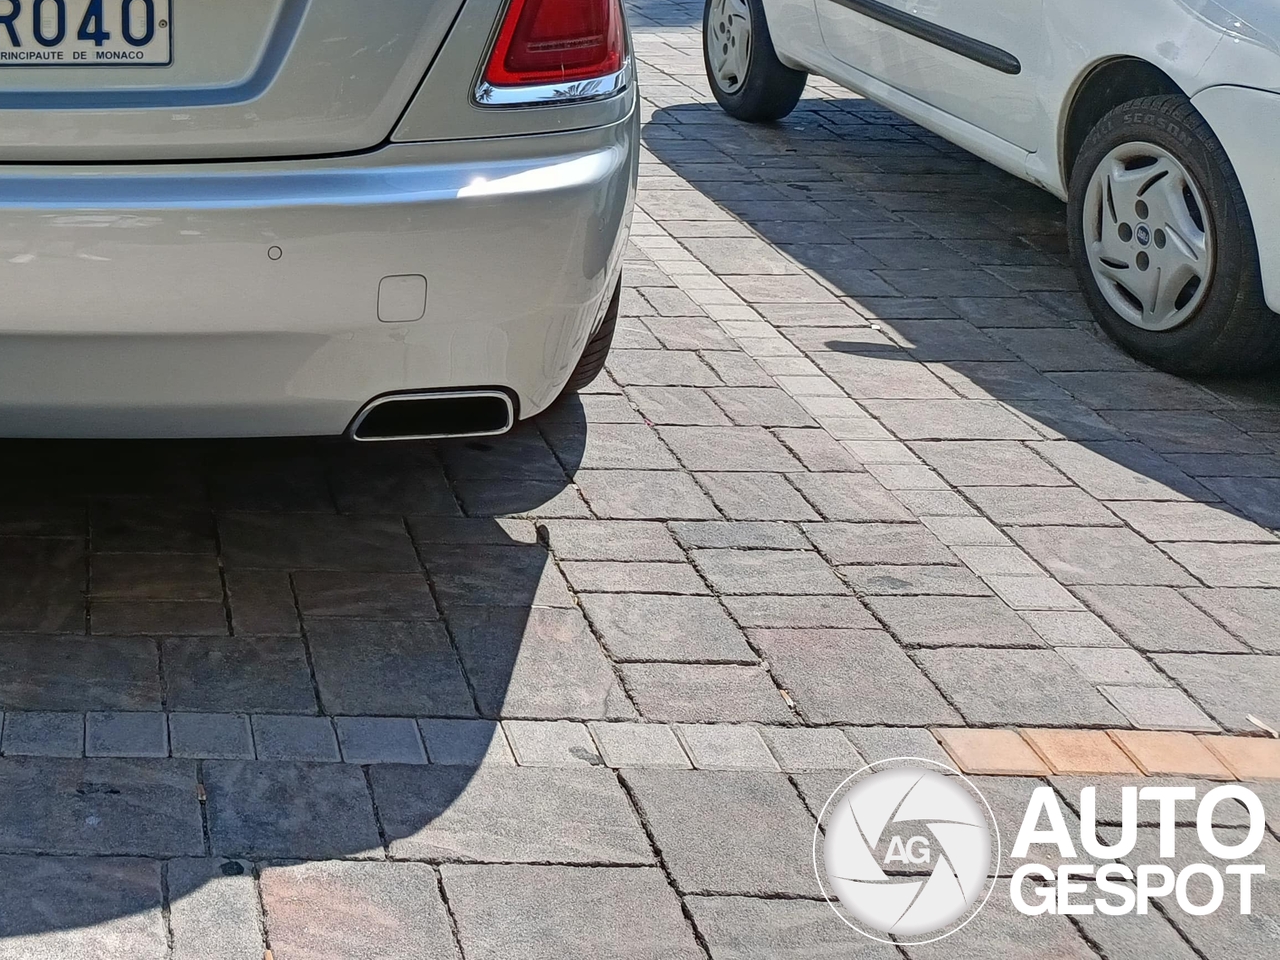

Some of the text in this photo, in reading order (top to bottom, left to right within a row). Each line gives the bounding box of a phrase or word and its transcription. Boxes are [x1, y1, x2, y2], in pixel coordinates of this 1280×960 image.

[73, 51, 87, 60] DE
[95, 51, 144, 60] MONACO
[1123, 113, 1192, 147] SEASON
